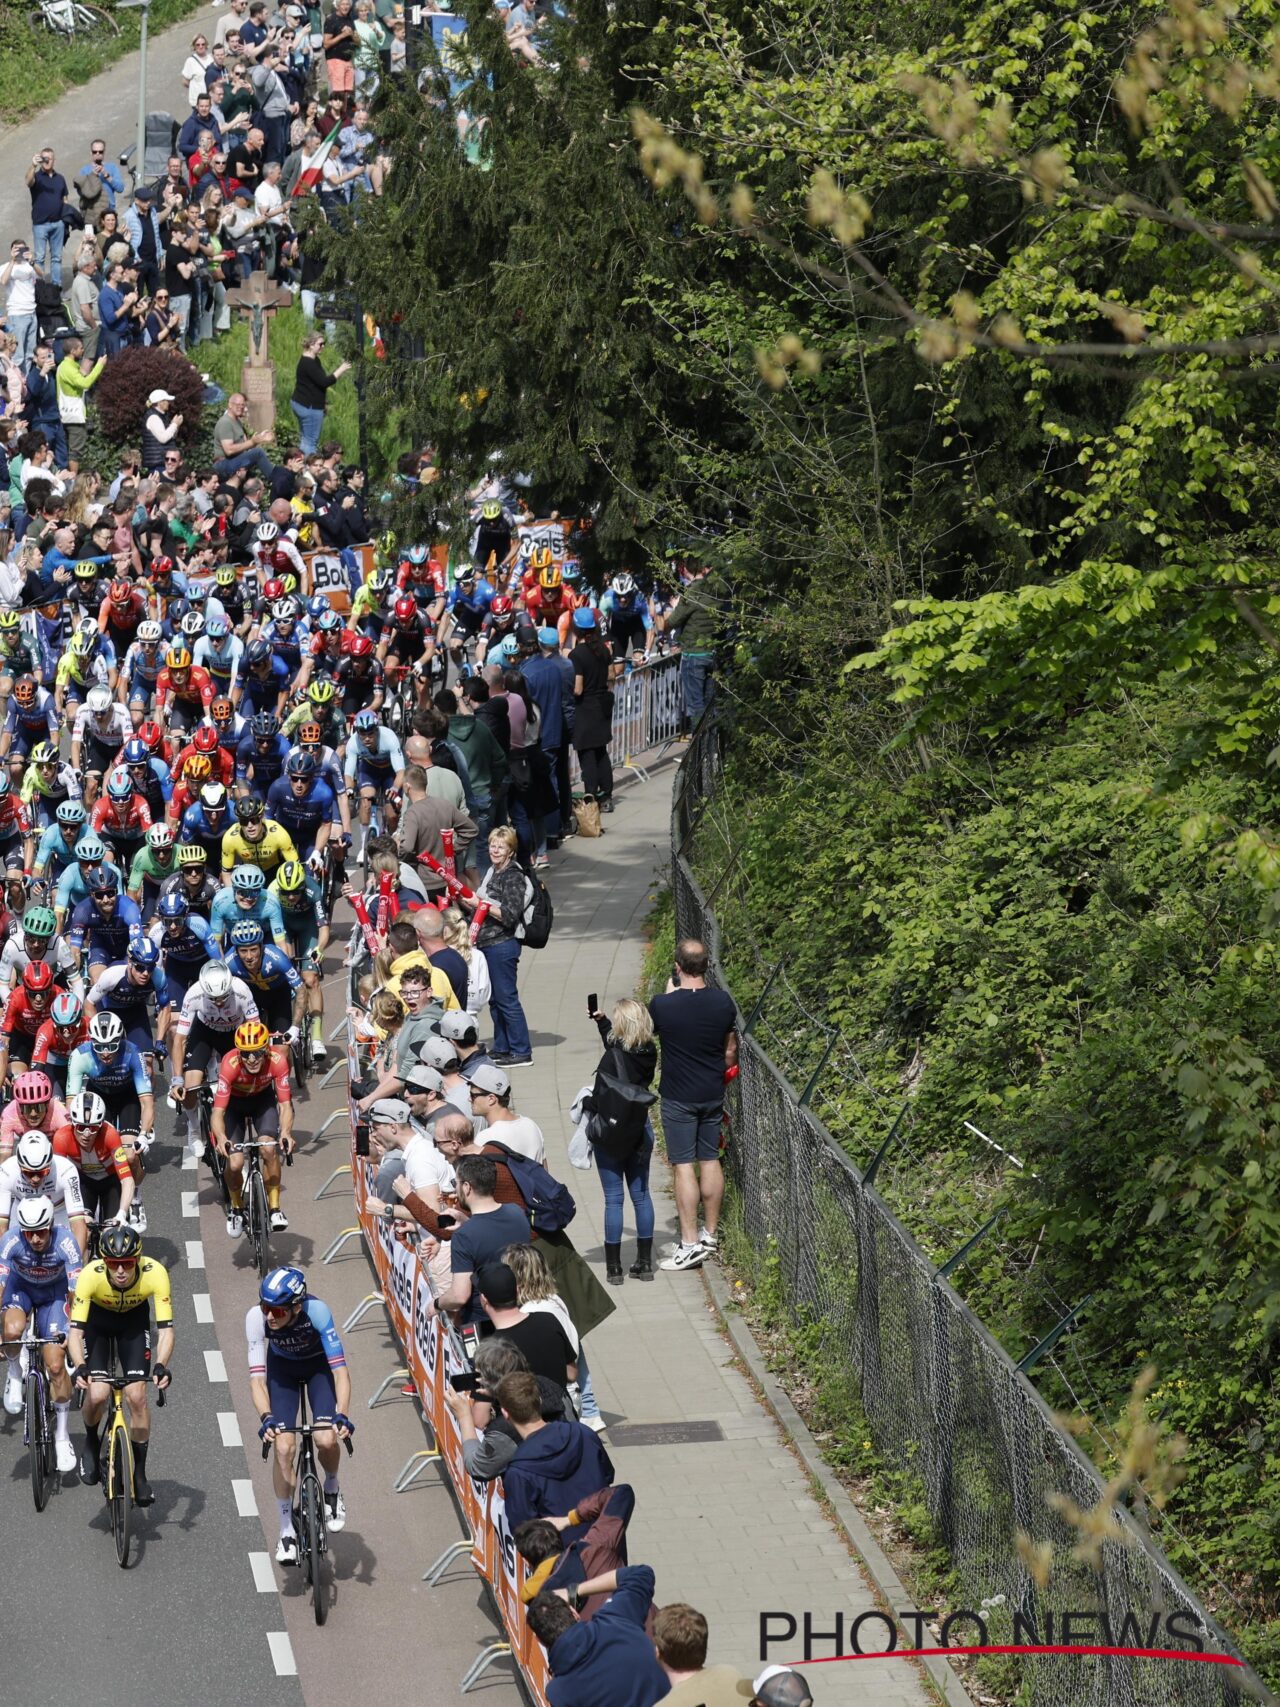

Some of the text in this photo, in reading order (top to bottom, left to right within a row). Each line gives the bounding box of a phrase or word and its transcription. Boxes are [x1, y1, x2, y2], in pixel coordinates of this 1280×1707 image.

[314, 899, 326, 920] BORA
[69, 1175, 81, 1203] Alpecin
[60, 1236, 81, 1264] Alpecin
